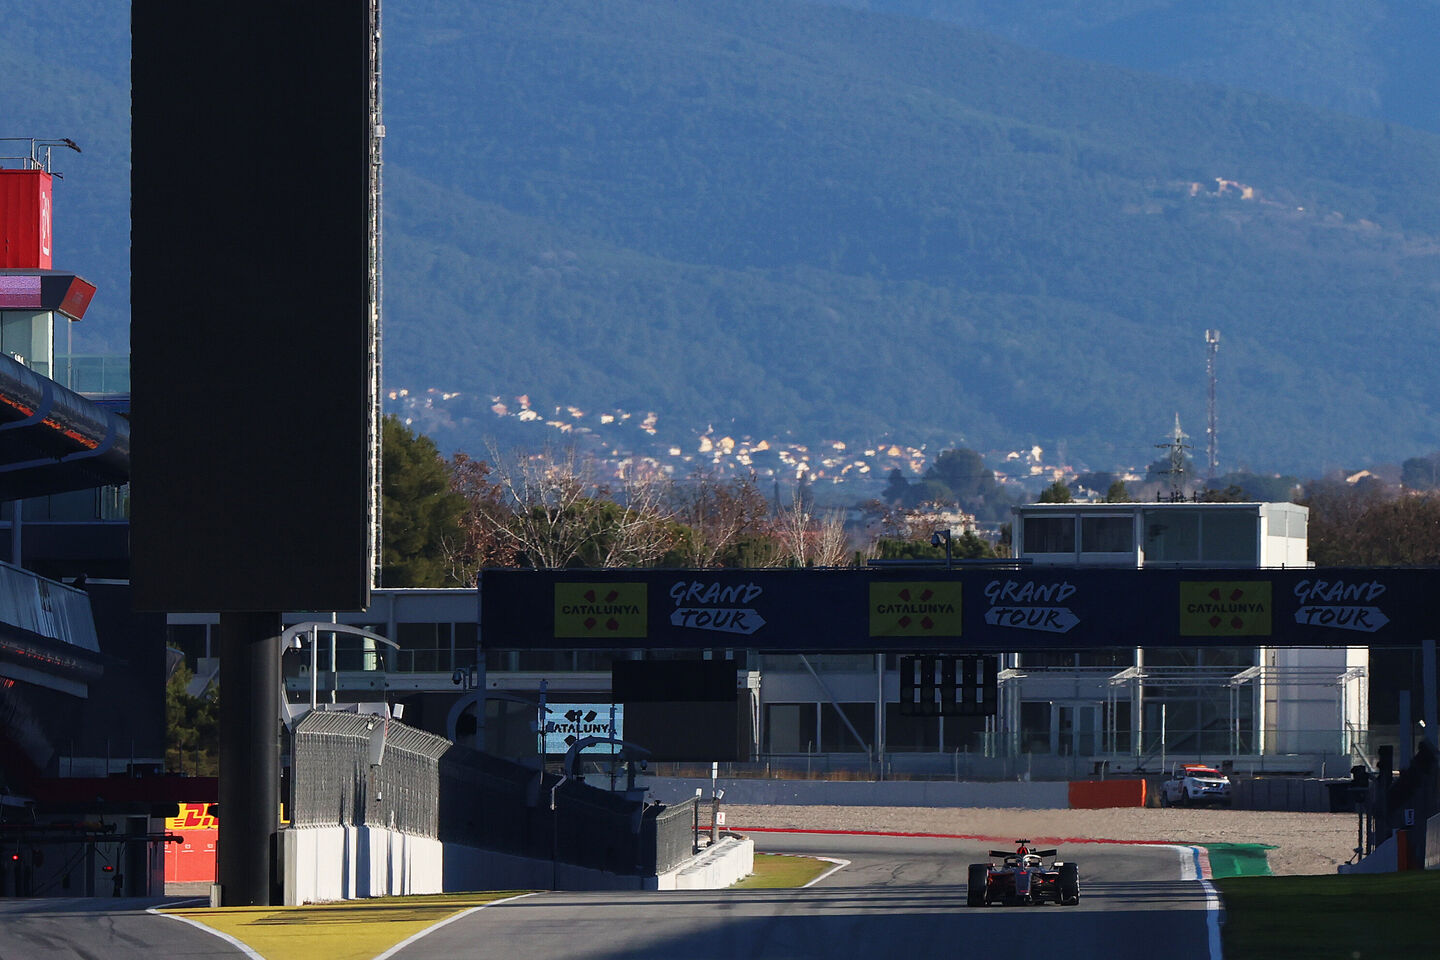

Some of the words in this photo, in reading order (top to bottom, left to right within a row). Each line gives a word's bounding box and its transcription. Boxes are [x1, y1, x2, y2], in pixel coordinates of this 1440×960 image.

[669, 580, 763, 607] GRAND
[984, 579, 1077, 606] GRAND
[1294, 579, 1387, 604] GRAND
[562, 605, 640, 615] CATALUNYA
[681, 608, 750, 630] TOUR
[877, 604, 955, 615] CATALUNYA
[995, 607, 1065, 629] TOUR
[1186, 603, 1265, 614] CATALUNYA
[1304, 607, 1374, 628] TOUR
[547, 723, 616, 733] ATALUNY
